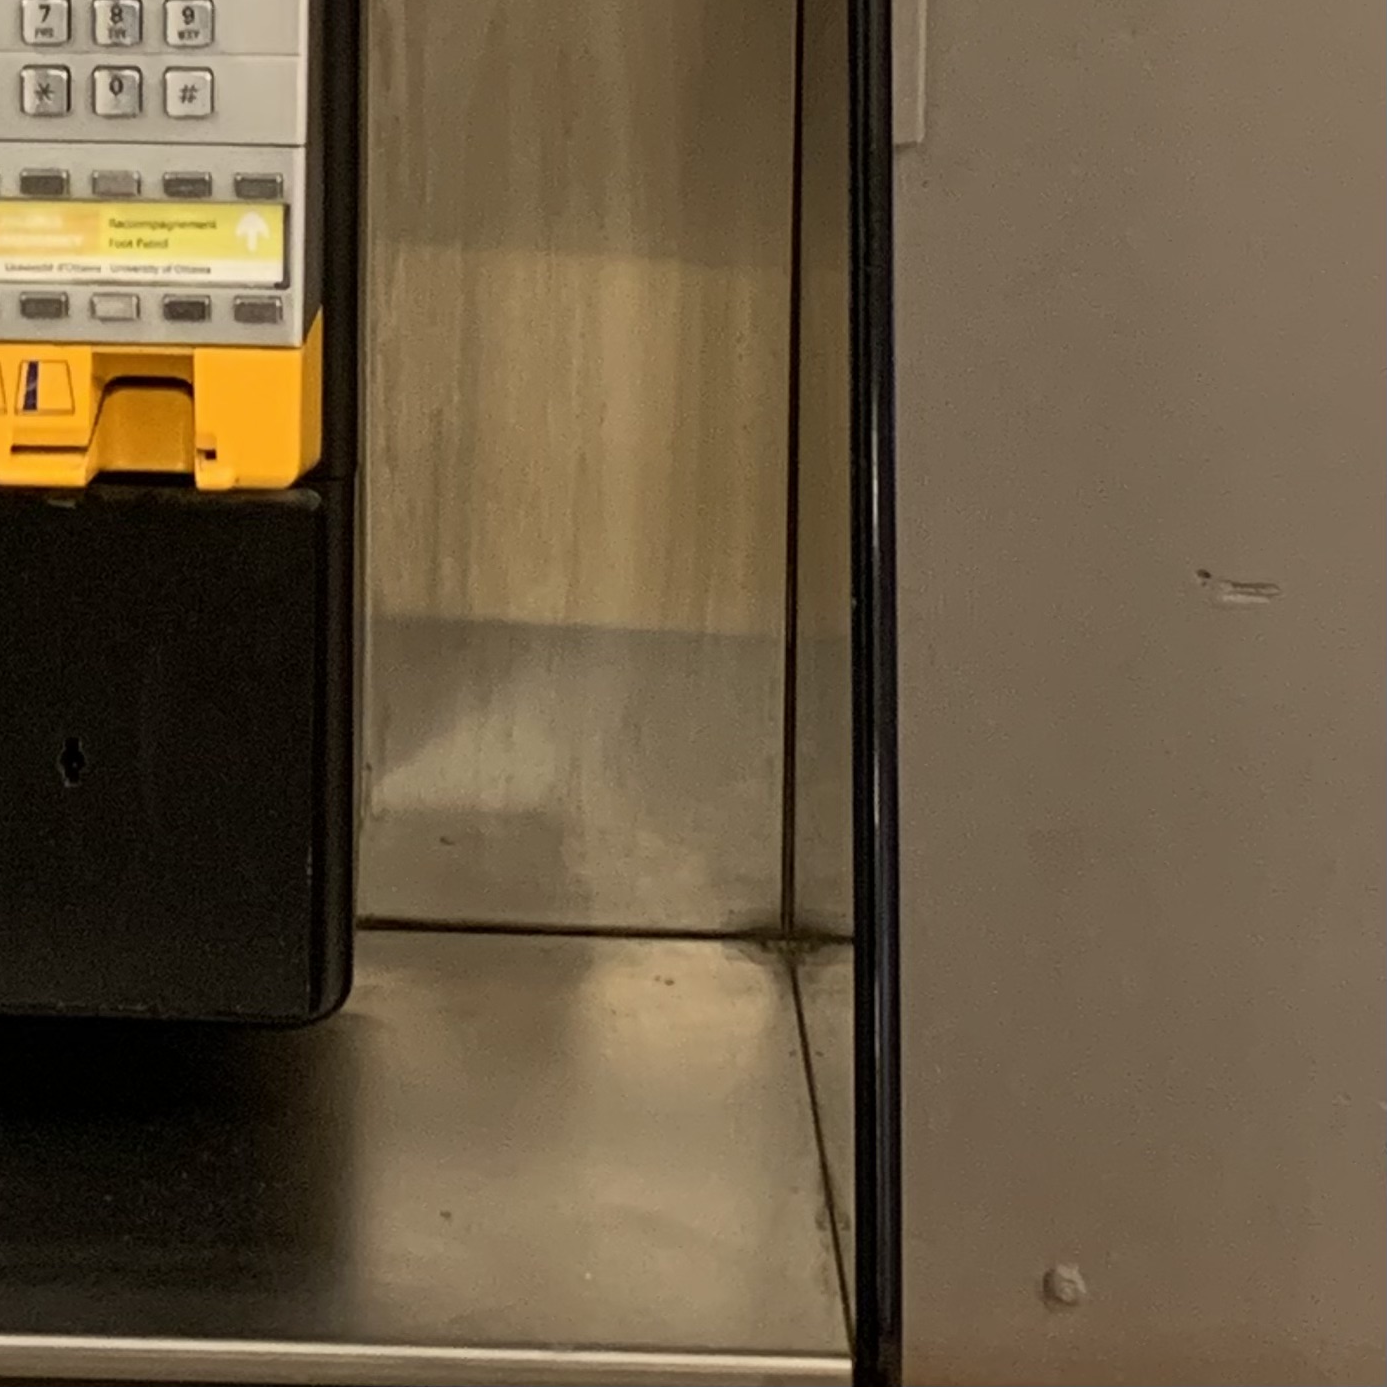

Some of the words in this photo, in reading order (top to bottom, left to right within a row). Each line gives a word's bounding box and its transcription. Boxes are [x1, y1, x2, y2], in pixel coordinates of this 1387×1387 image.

[39, 4, 51, 24] 7
[110, 3, 123, 24] 8
[182, 6, 195, 25] 9
[109, 76, 123, 96] 0
